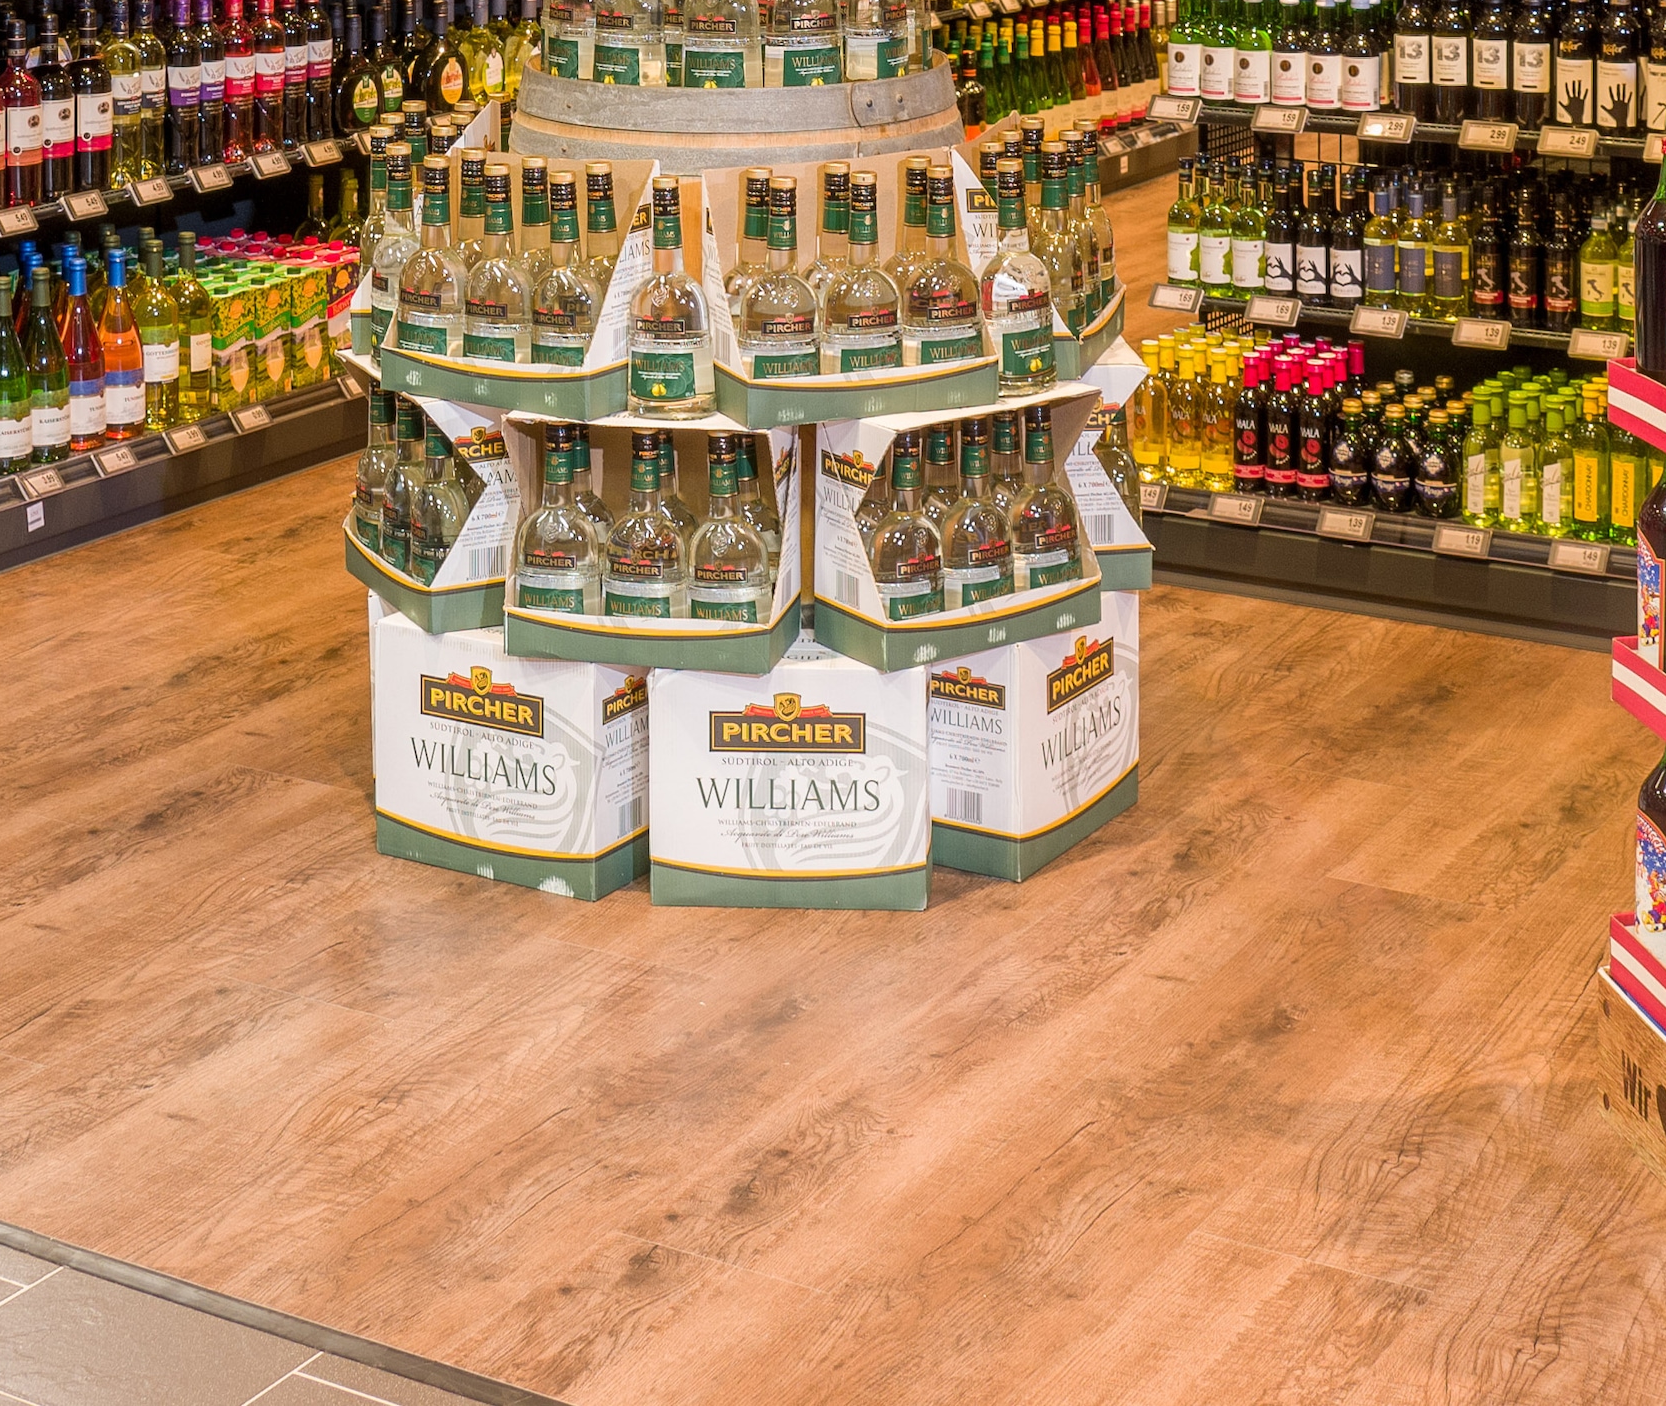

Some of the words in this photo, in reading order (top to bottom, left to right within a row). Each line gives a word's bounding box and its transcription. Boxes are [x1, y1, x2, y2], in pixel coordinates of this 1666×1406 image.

[691, 20, 734, 32] PIRCHER
[1435, 42, 1461, 60] 13
[636, 320, 682, 331] PIRCHER
[527, 556, 573, 567] PIRCHER
[524, 593, 574, 608] WILLIAMS
[1052, 653, 1109, 700] PIRCHER
[931, 679, 998, 703] PIRCHER
[430, 688, 534, 726] PIRCHER
[723, 723, 854, 743] PIRCHER
[931, 708, 1002, 735] WILLIAMS
[1041, 696, 1121, 770] WILLIAMS
[430, 722, 474, 737] SÜDTIROL
[481, 732, 504, 744] ALTO
[506, 737, 534, 749] ADIGE
[411, 737, 556, 795] WILLIAMS
[722, 757, 777, 766] SÜDTIROL
[696, 778, 880, 811] WILLIAMS
[1622, 1050, 1651, 1121] Wir
